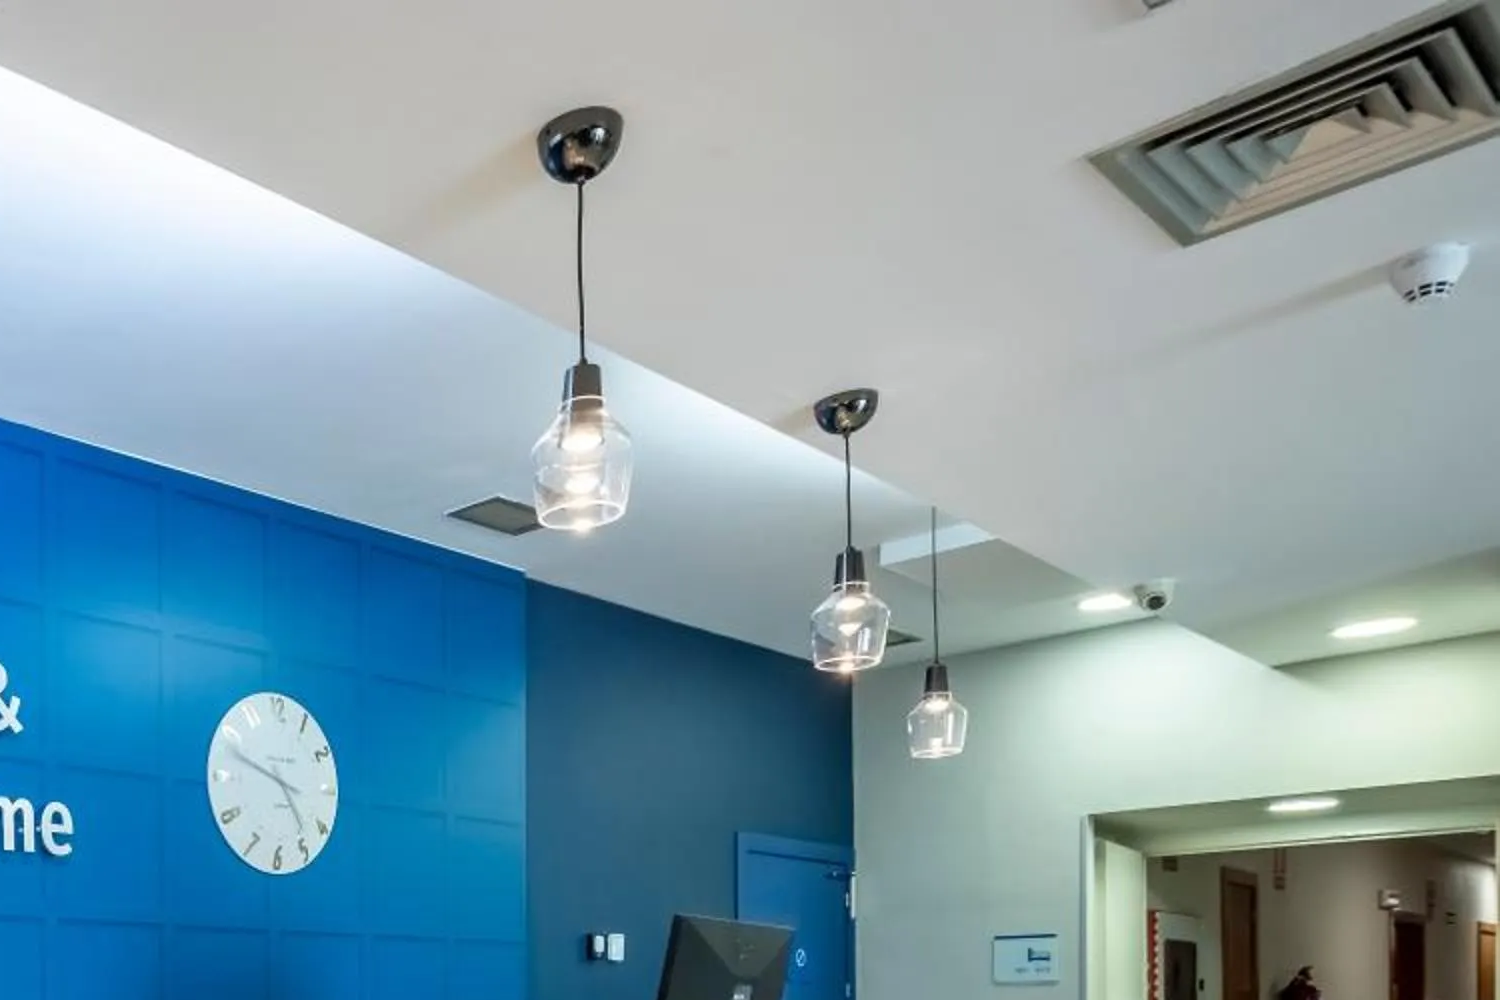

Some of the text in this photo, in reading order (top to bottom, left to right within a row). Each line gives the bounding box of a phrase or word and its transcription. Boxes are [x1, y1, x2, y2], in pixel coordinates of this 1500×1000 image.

[270, 696, 285, 723] 12
[300, 712, 308, 733] 1
[315, 745, 329, 763] 2
[221, 806, 241, 825] 8
[315, 817, 328, 835] 4
[243, 831, 261, 856] 7
[298, 837, 309, 865] 5
[272, 844, 283, 870] 6
